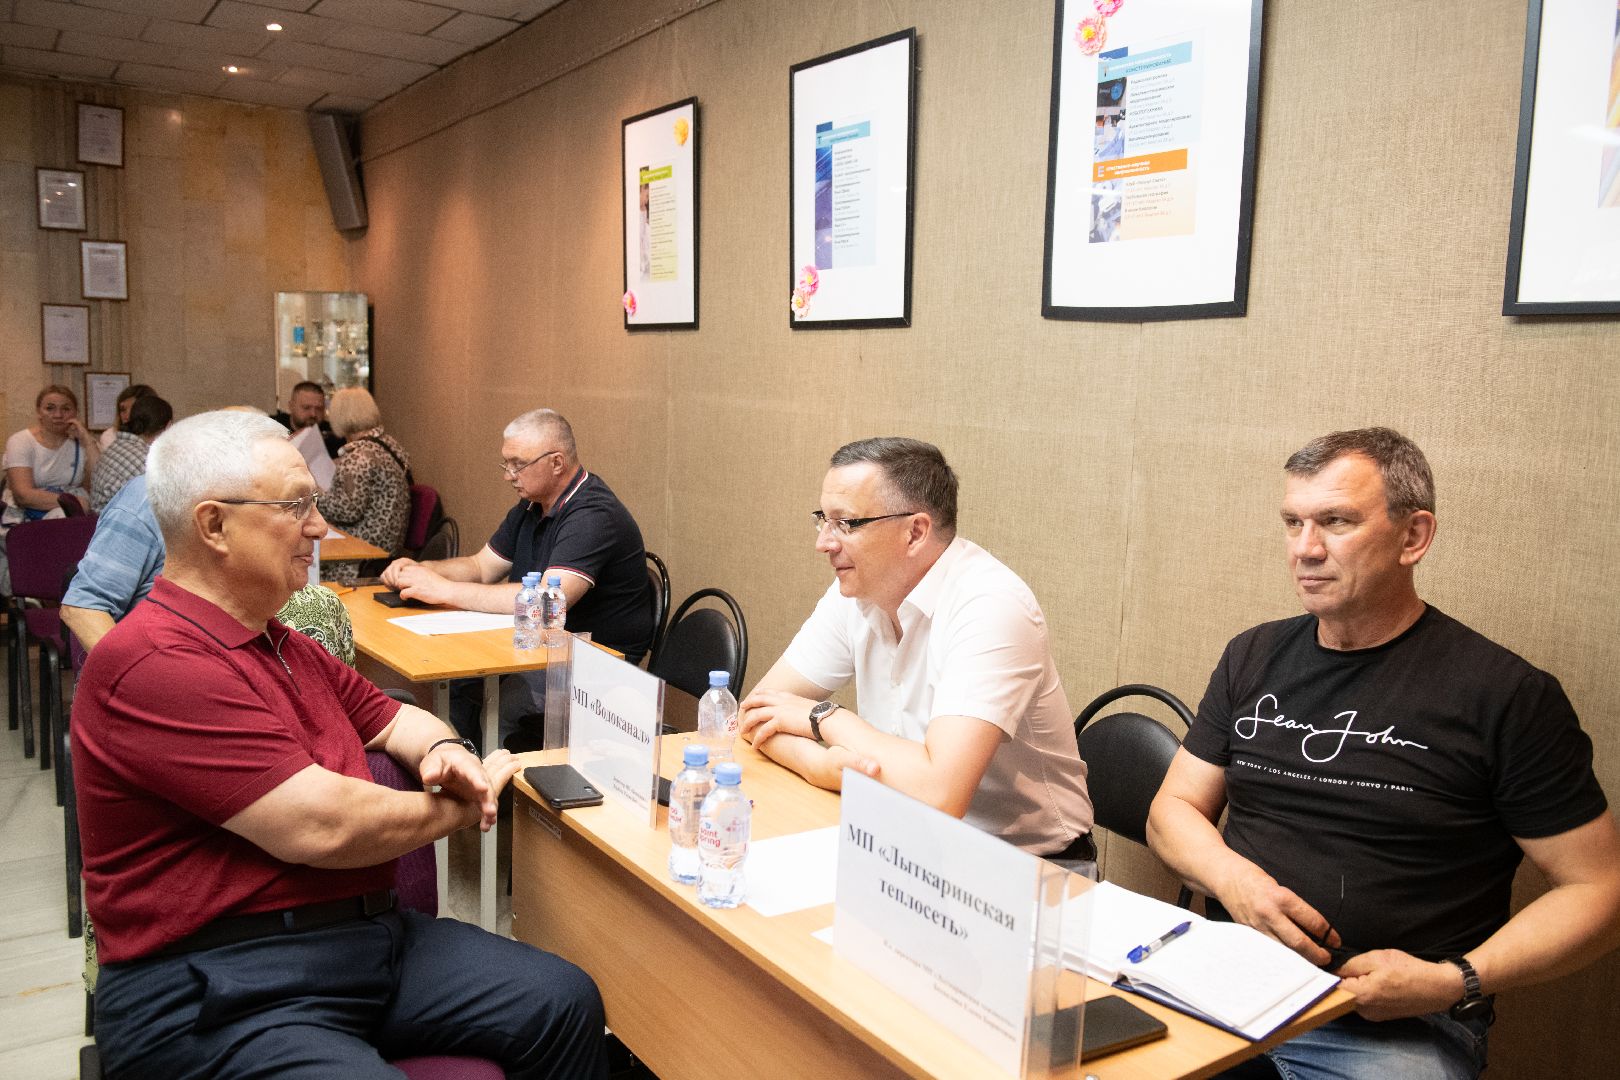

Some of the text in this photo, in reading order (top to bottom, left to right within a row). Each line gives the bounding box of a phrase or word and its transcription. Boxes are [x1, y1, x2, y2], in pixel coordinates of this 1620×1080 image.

[573, 685, 650, 744] МП «Водоканал»
[1269, 767, 1281, 775] LOS
[1283, 771, 1311, 781] ANGELES
[1319, 777, 1348, 786] LONDON
[1356, 781, 1381, 789] TOKYO
[1391, 784, 1414, 792] PARIS
[848, 823, 1016, 932] МП «Лыткаринская
[879, 878, 969, 940] теплосеть»
